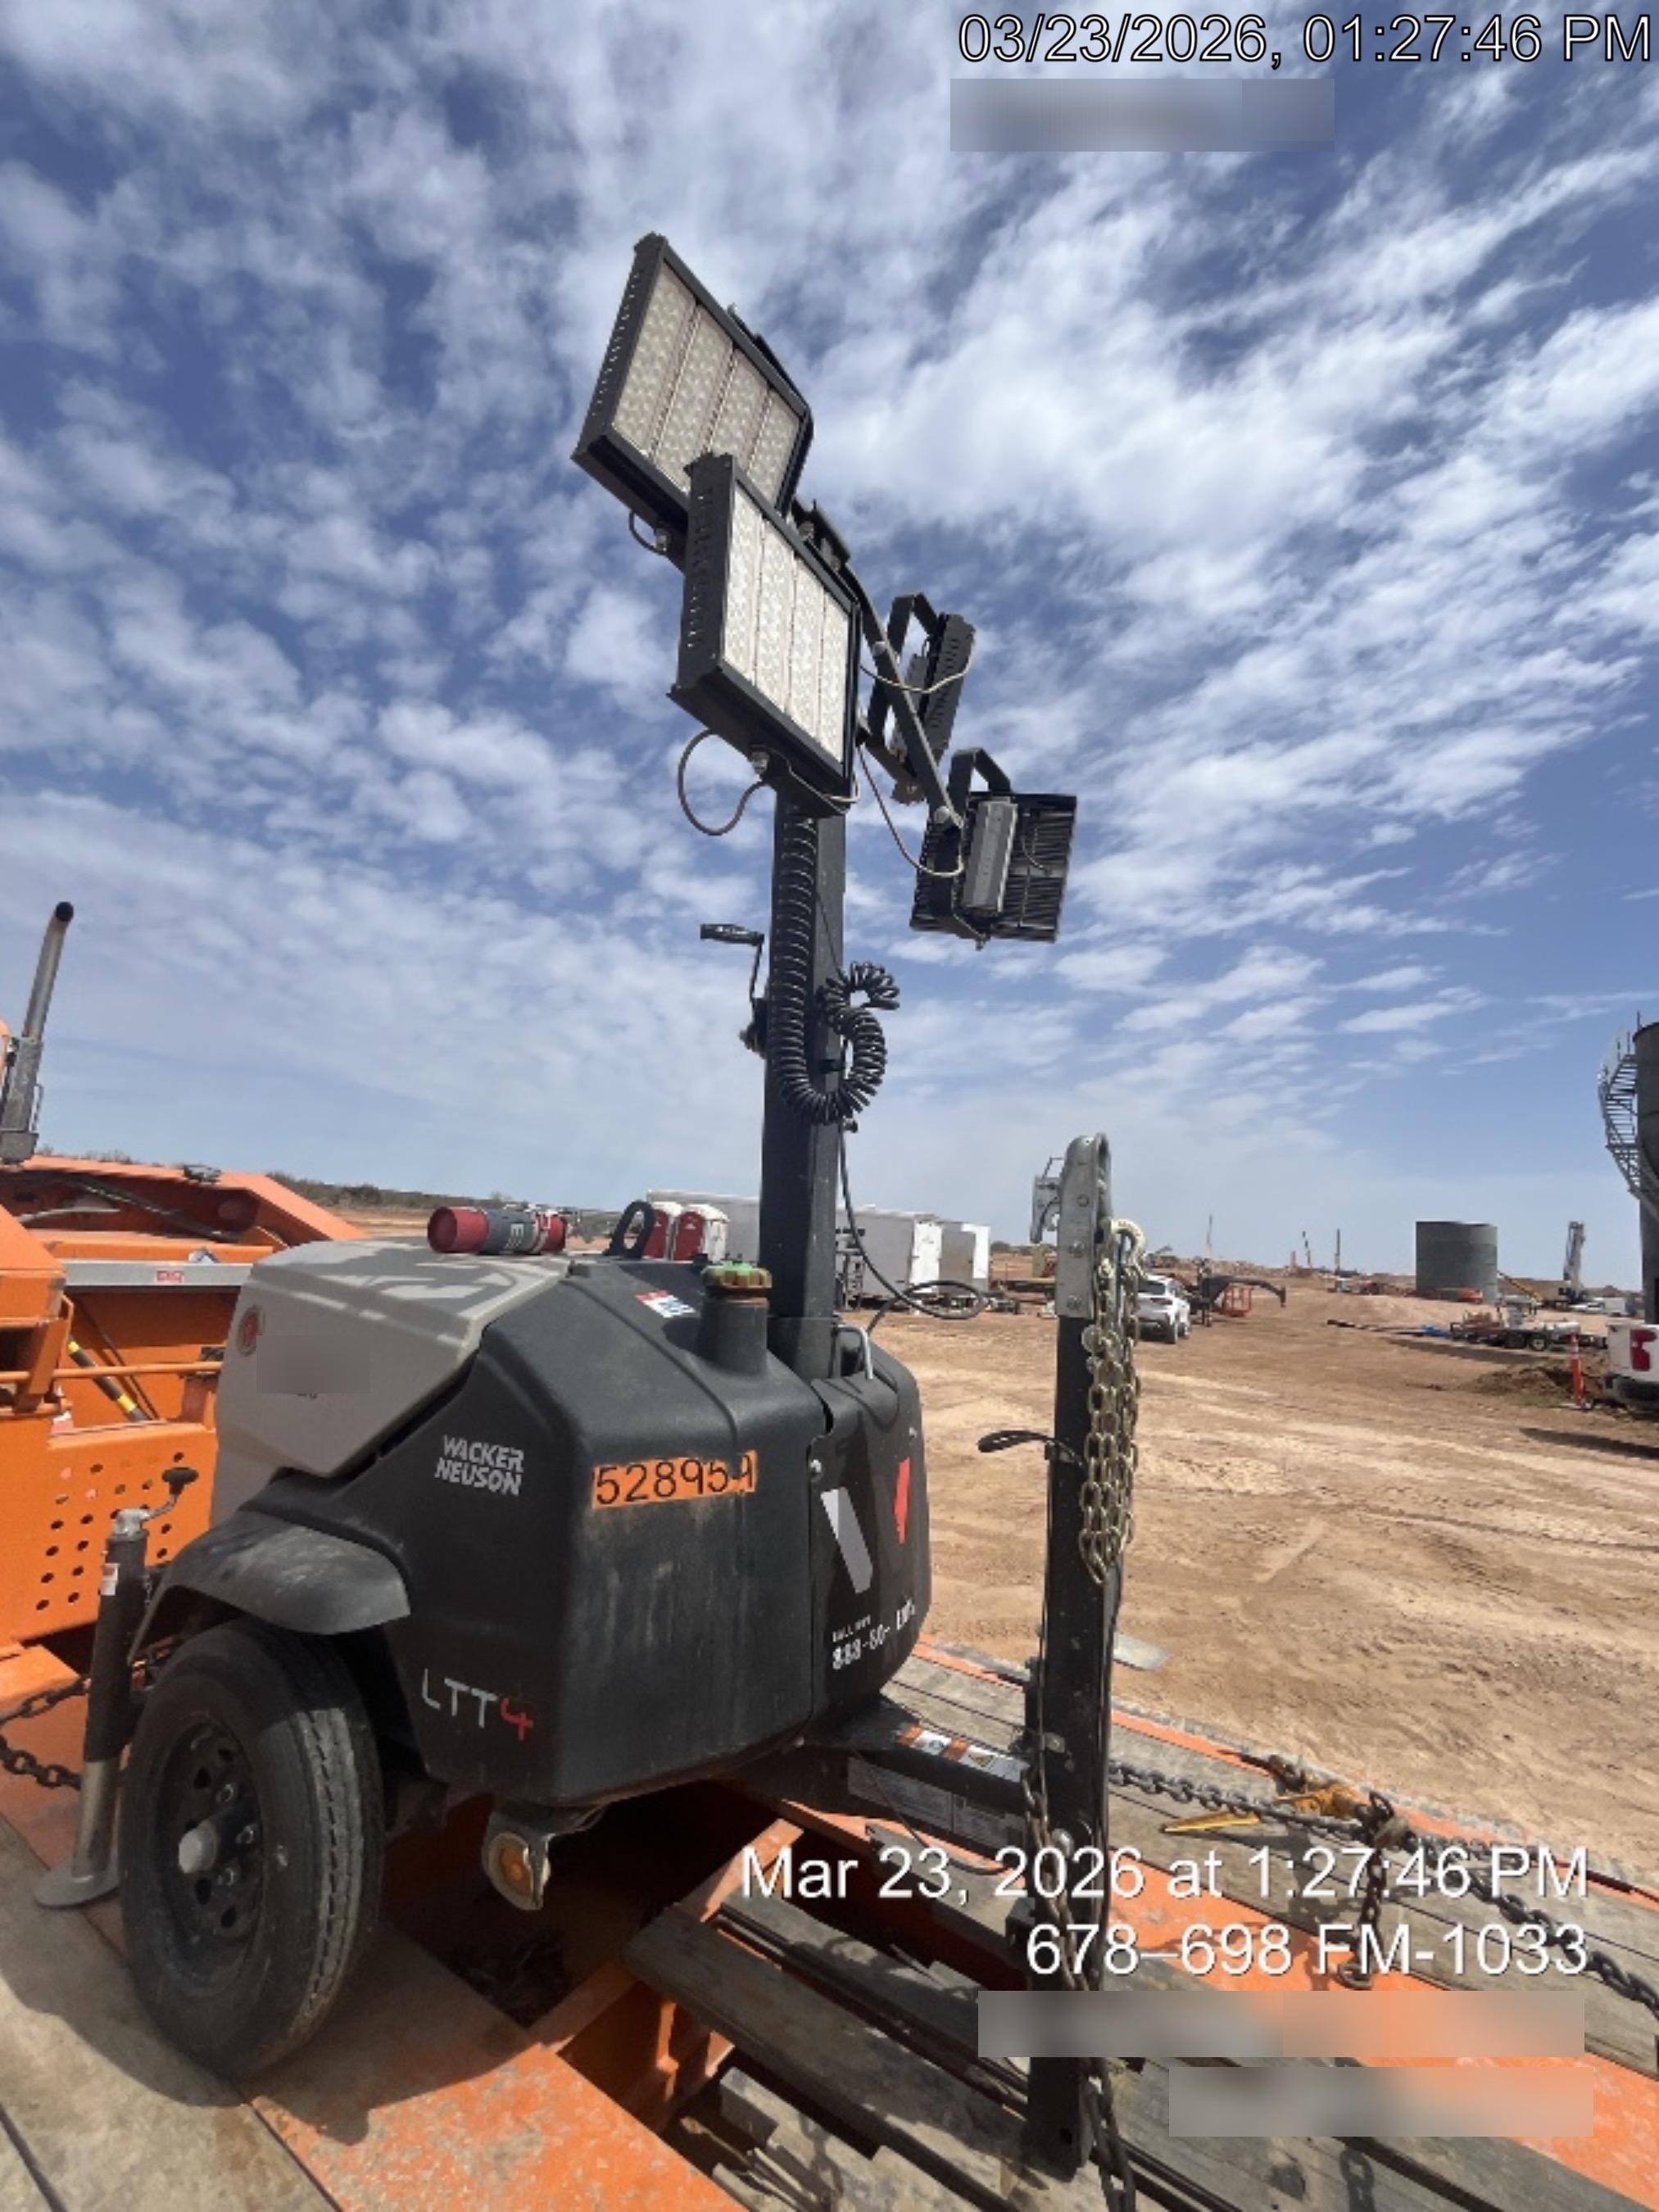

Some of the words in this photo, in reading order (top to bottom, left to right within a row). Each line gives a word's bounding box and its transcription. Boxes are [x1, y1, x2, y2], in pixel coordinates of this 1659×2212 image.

[443, 1435, 524, 1473] WACKER
[434, 1457, 522, 1496] NEUSON
[422, 1668, 533, 1741] LTT4
